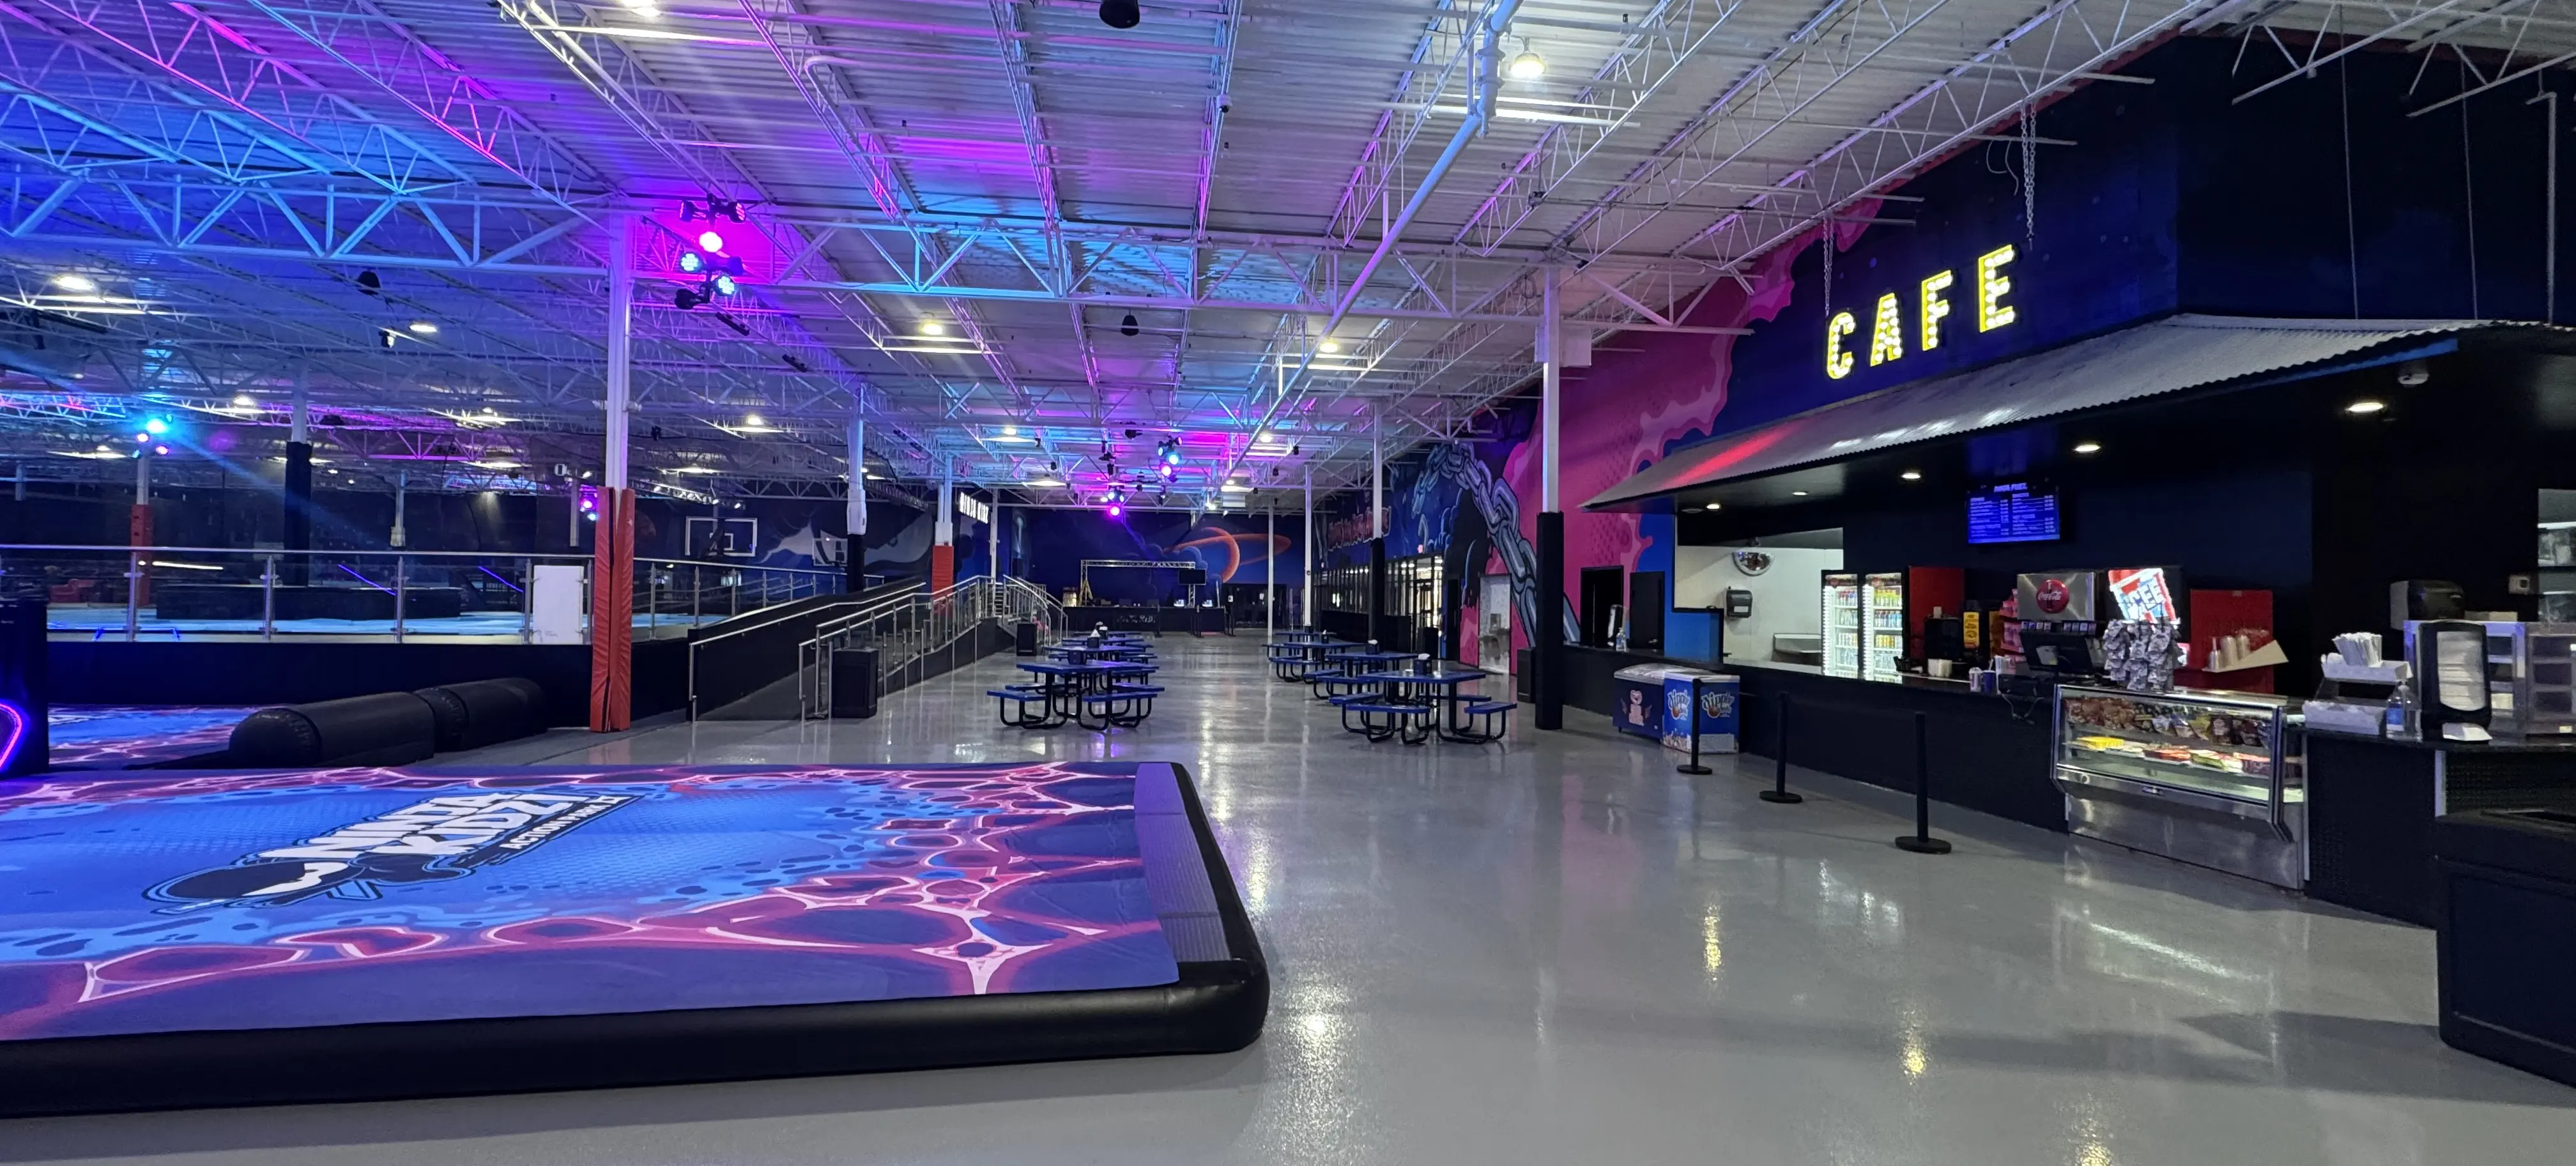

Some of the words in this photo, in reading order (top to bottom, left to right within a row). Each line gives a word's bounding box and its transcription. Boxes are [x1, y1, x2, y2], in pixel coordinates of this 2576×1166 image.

[1827, 244, 2015, 380] CAFE
[257, 793, 515, 859] NINJA
[500, 819, 572, 850] ACTION
[557, 803, 612, 820] PARK
